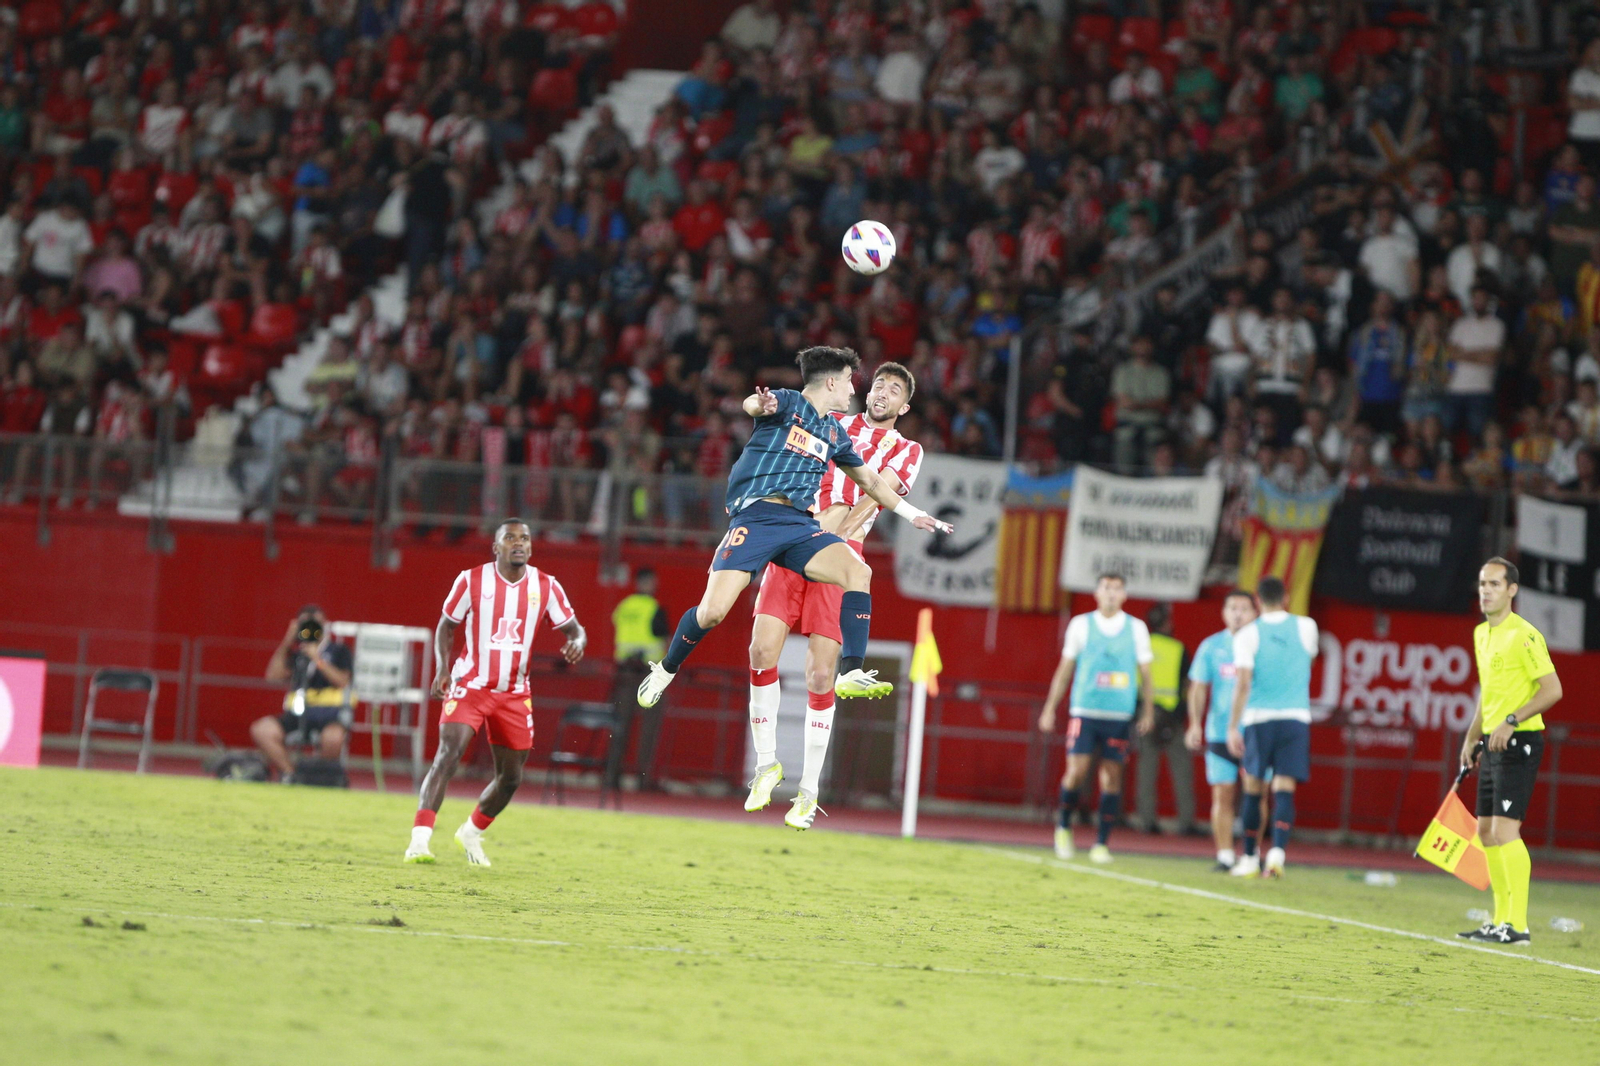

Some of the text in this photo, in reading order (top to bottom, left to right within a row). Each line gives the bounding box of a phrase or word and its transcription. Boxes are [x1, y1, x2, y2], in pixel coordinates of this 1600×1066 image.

[793, 431, 807, 446] TM
[724, 526, 749, 549] 16
[493, 619, 522, 642] JK
[1345, 638, 1471, 687] grupo
[811, 721, 830, 730] UDA
